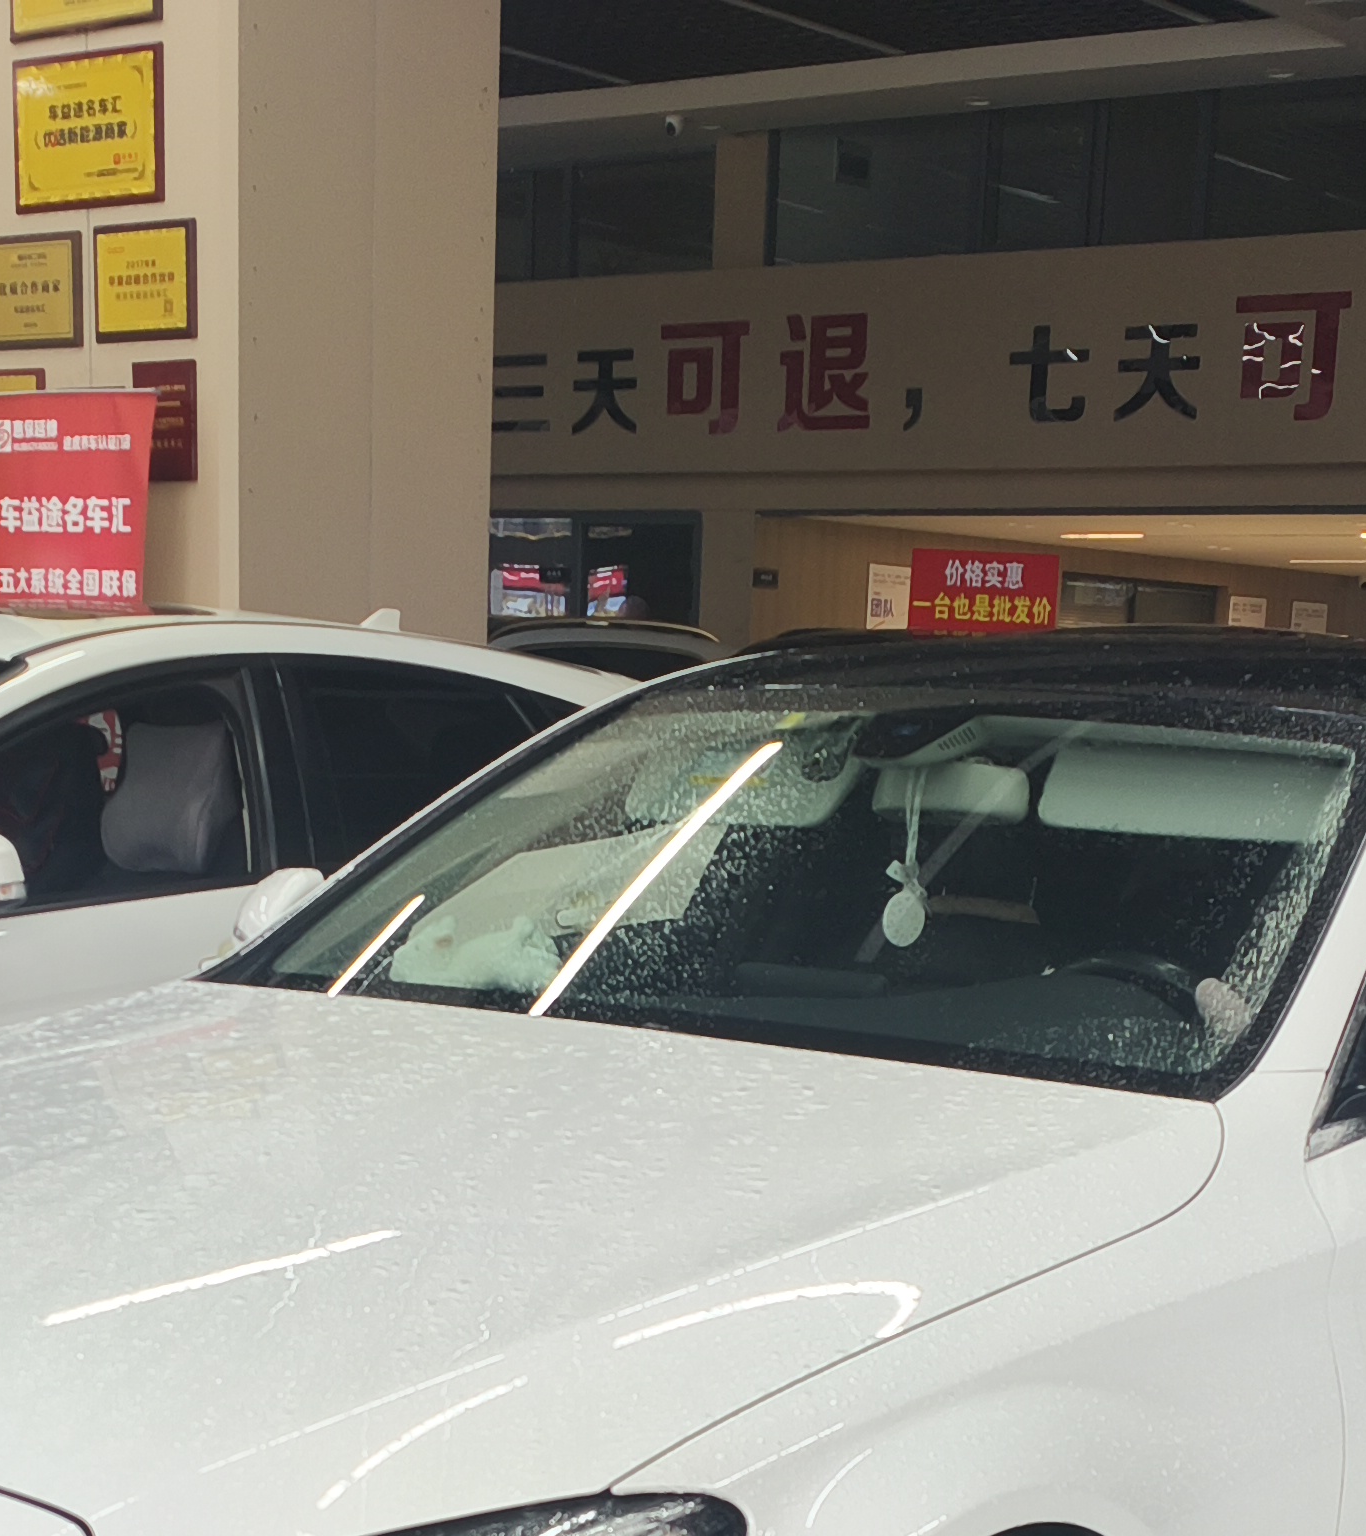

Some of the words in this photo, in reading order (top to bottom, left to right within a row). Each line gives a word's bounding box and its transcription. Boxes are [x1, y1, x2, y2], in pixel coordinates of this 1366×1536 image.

[0, 496, 132, 534] 车益途名车汇
[944, 559, 1024, 589] 价格实惠
[912, 591, 1052, 625] 一台也是批发价
